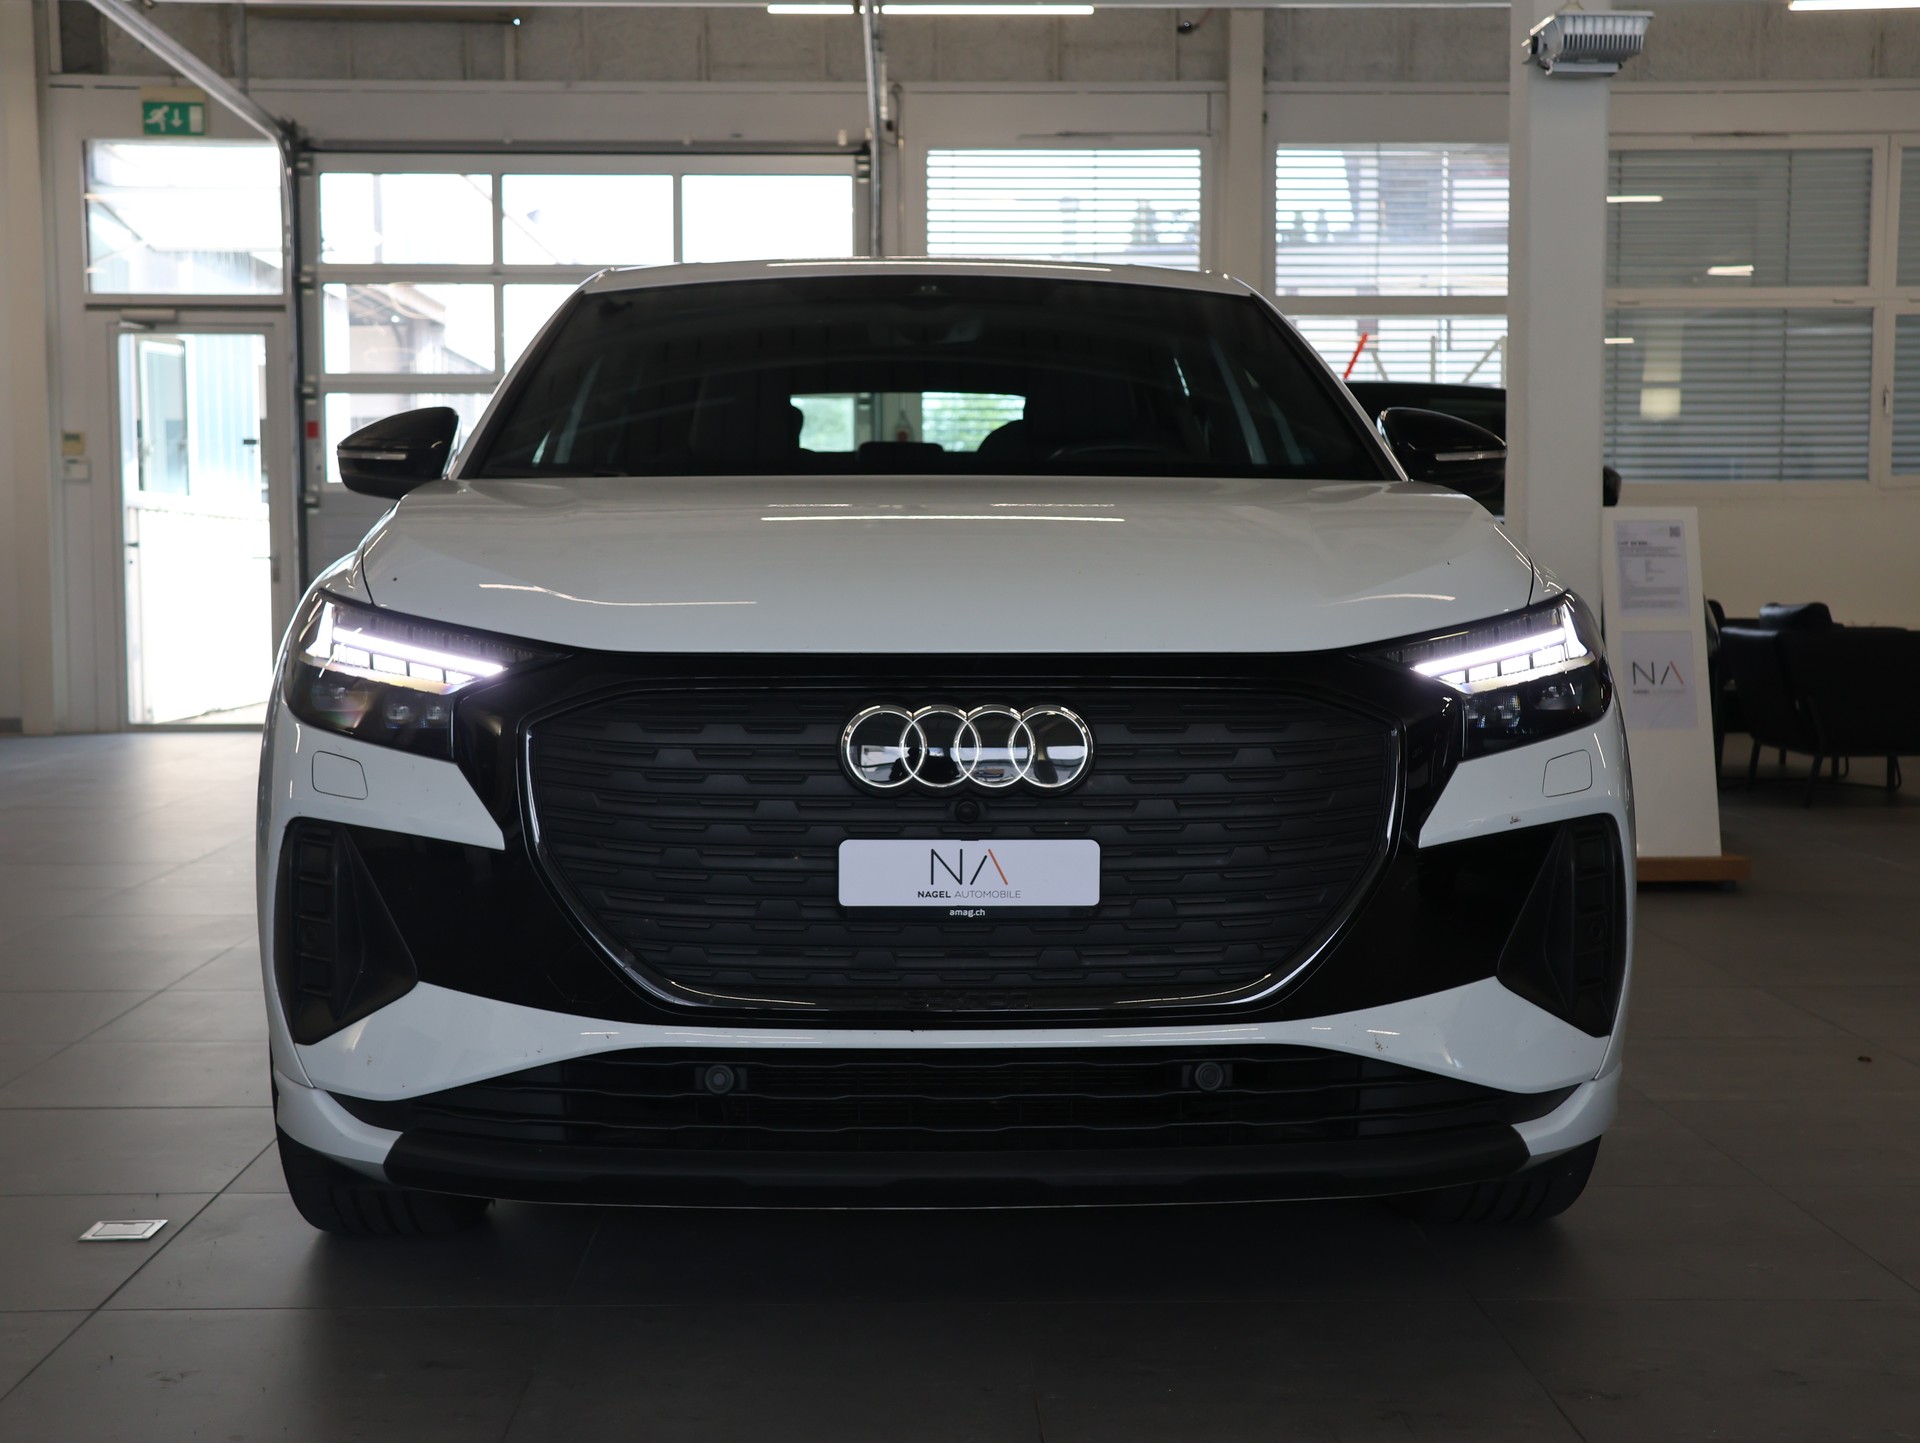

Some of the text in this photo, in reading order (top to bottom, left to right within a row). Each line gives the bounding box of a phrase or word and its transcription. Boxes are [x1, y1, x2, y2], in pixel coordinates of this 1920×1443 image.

[1632, 660, 1684, 685] NA
[930, 848, 1008, 885] NA
[917, 890, 1021, 898] NAGEL AUTOMOBILE
[949, 908, 986, 918] amag.ch
